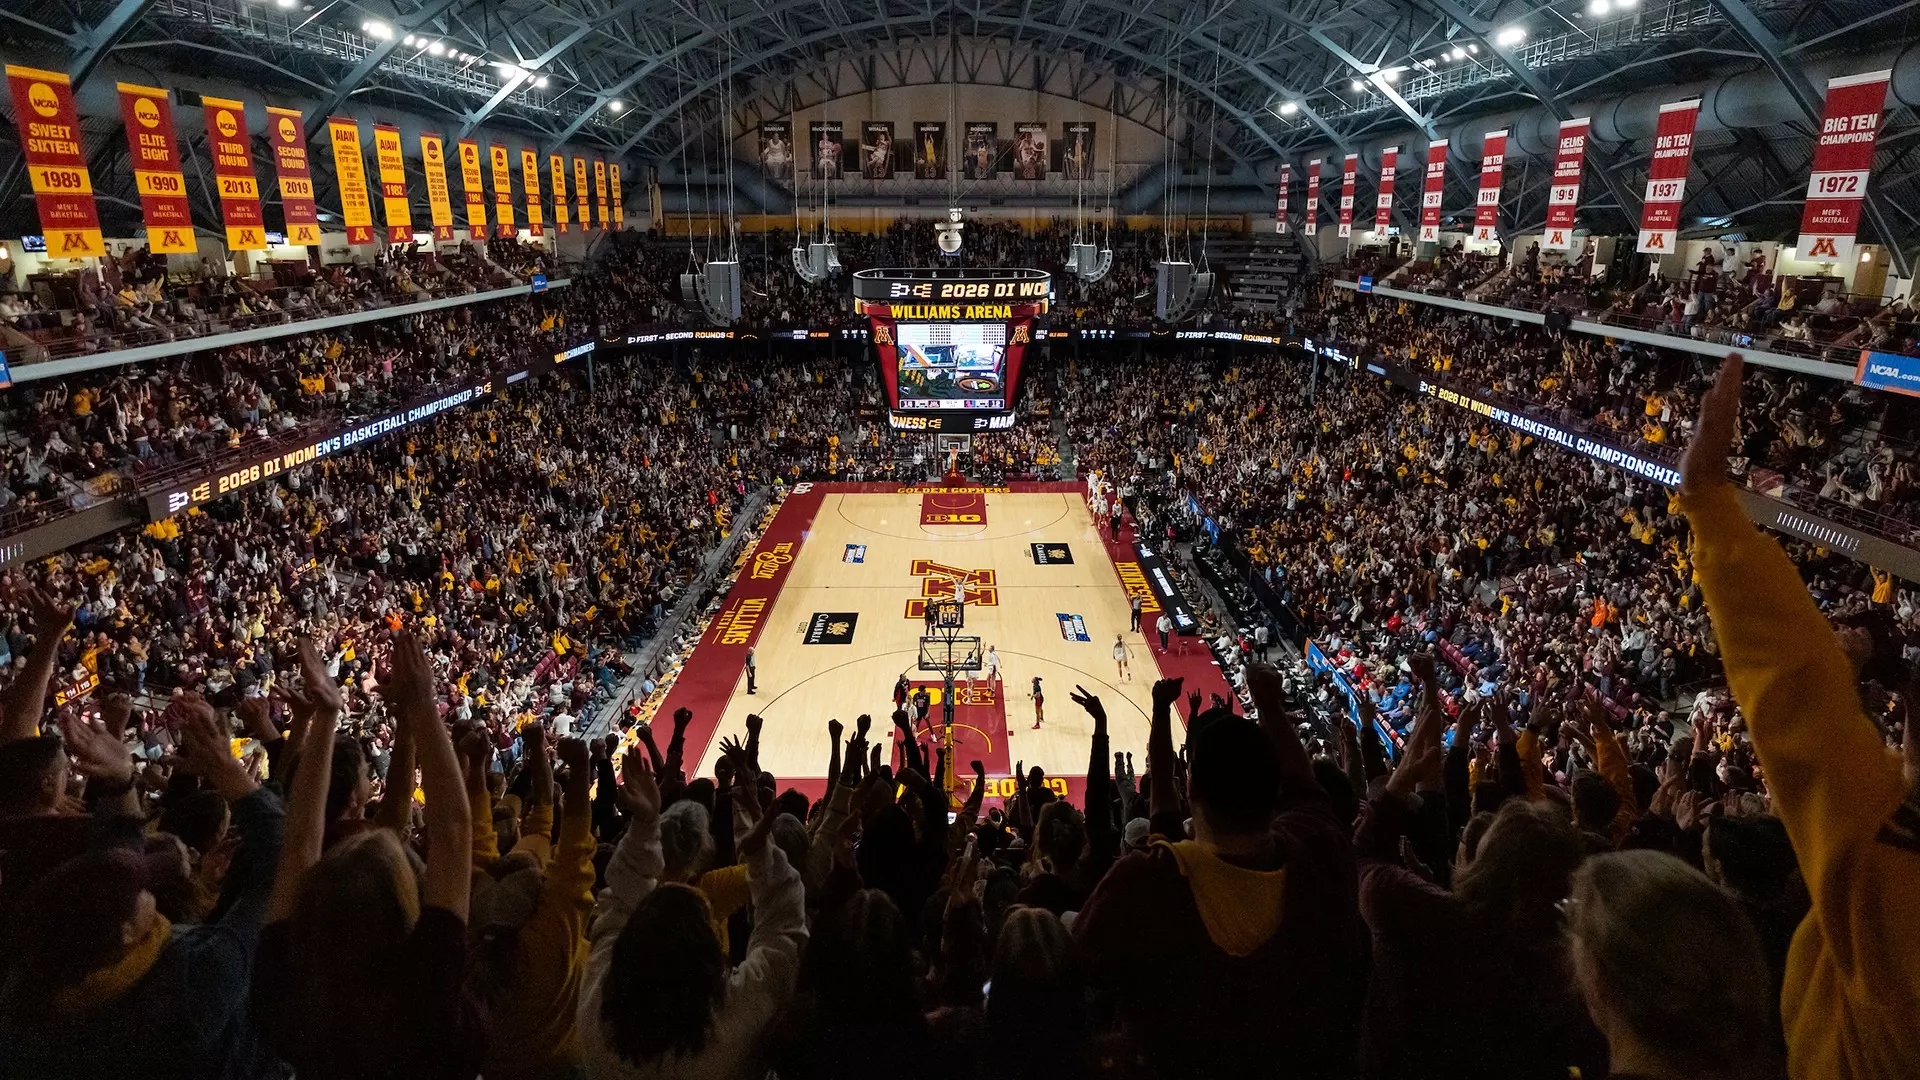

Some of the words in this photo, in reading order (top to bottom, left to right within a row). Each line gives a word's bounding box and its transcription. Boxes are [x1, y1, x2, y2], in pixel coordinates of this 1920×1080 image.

[33, 98, 59, 109] NCAA
[138, 112, 160, 121] NCAA
[1823, 116, 1848, 133] BIG
[1850, 113, 1878, 130] TEN
[29, 122, 71, 139] SWEET
[219, 122, 238, 131] NCAA
[281, 128, 297, 136] NCAA
[139, 133, 166, 147] ELITE
[1560, 136, 1584, 148] HELMS
[1656, 135, 1672, 149] BIG
[1674, 133, 1691, 147] TEN
[1820, 131, 1875, 145] CHAMPIONS
[28, 138, 80, 156] SIXTEEN
[141, 147, 169, 161] EIGHT
[218, 142, 243, 155] THIRD
[277, 146, 305, 157] SECOND
[1654, 147, 1689, 159] CHAMPIONS
[219, 154, 248, 167] ROUND
[281, 159, 305, 169] ROUND
[1483, 156, 1493, 165] BIG
[1493, 155, 1503, 164] TEN
[41, 171, 81, 188] 1989
[1554, 168, 1580, 177] CHAMPIONS
[145, 176, 179, 191] 1990
[224, 180, 252, 194] 2013
[285, 181, 309, 194] 2019
[1652, 183, 1678, 197] 1937
[1818, 176, 1858, 192] 1972
[50, 210, 88, 219] BASKETBALL
[1822, 208, 1841, 216] MEN'S
[1811, 215, 1849, 224] BASKETBALL
[941, 284, 990, 298] 2026
[994, 283, 1015, 297] DI
[891, 306, 961, 319] WILLIAMS
[966, 305, 1013, 318] ARENA
[636, 334, 658, 343] FIRST
[666, 332, 693, 341] SECOND
[695, 332, 725, 340] ROUNDS
[874, 326, 894, 345] M
[1010, 325, 1030, 345] M
[1215, 332, 1242, 341] SECOND
[1244, 334, 1272, 344] ROUNDS
[1869, 363, 1920, 381] NCAA.com
[218, 466, 259, 494] 2026
[263, 457, 281, 477] DI
[284, 438, 341, 469] WOMEN'S
[343, 412, 406, 448] BASKETBALL
[408, 389, 472, 421] CHAMPIONSHIP
[1438, 388, 1458, 405] 2026
[1459, 395, 1469, 409] DI
[1470, 399, 1510, 424] WOMEN'S
[1511, 414, 1574, 449] BASKETBALL
[1576, 438, 1681, 487] CHAMPIONSHIP
[776, 542, 794, 554] THE
[1035, 543, 1048, 564] CAMBRIA
[751, 551, 793, 580] Barn
[904, 559, 999, 619] M
[1114, 561, 1162, 614] MINNESOTA
[716, 610, 734, 630] ARENA
[721, 598, 767, 645] WILLIAMS
[809, 613, 829, 643] CAMBRIA
